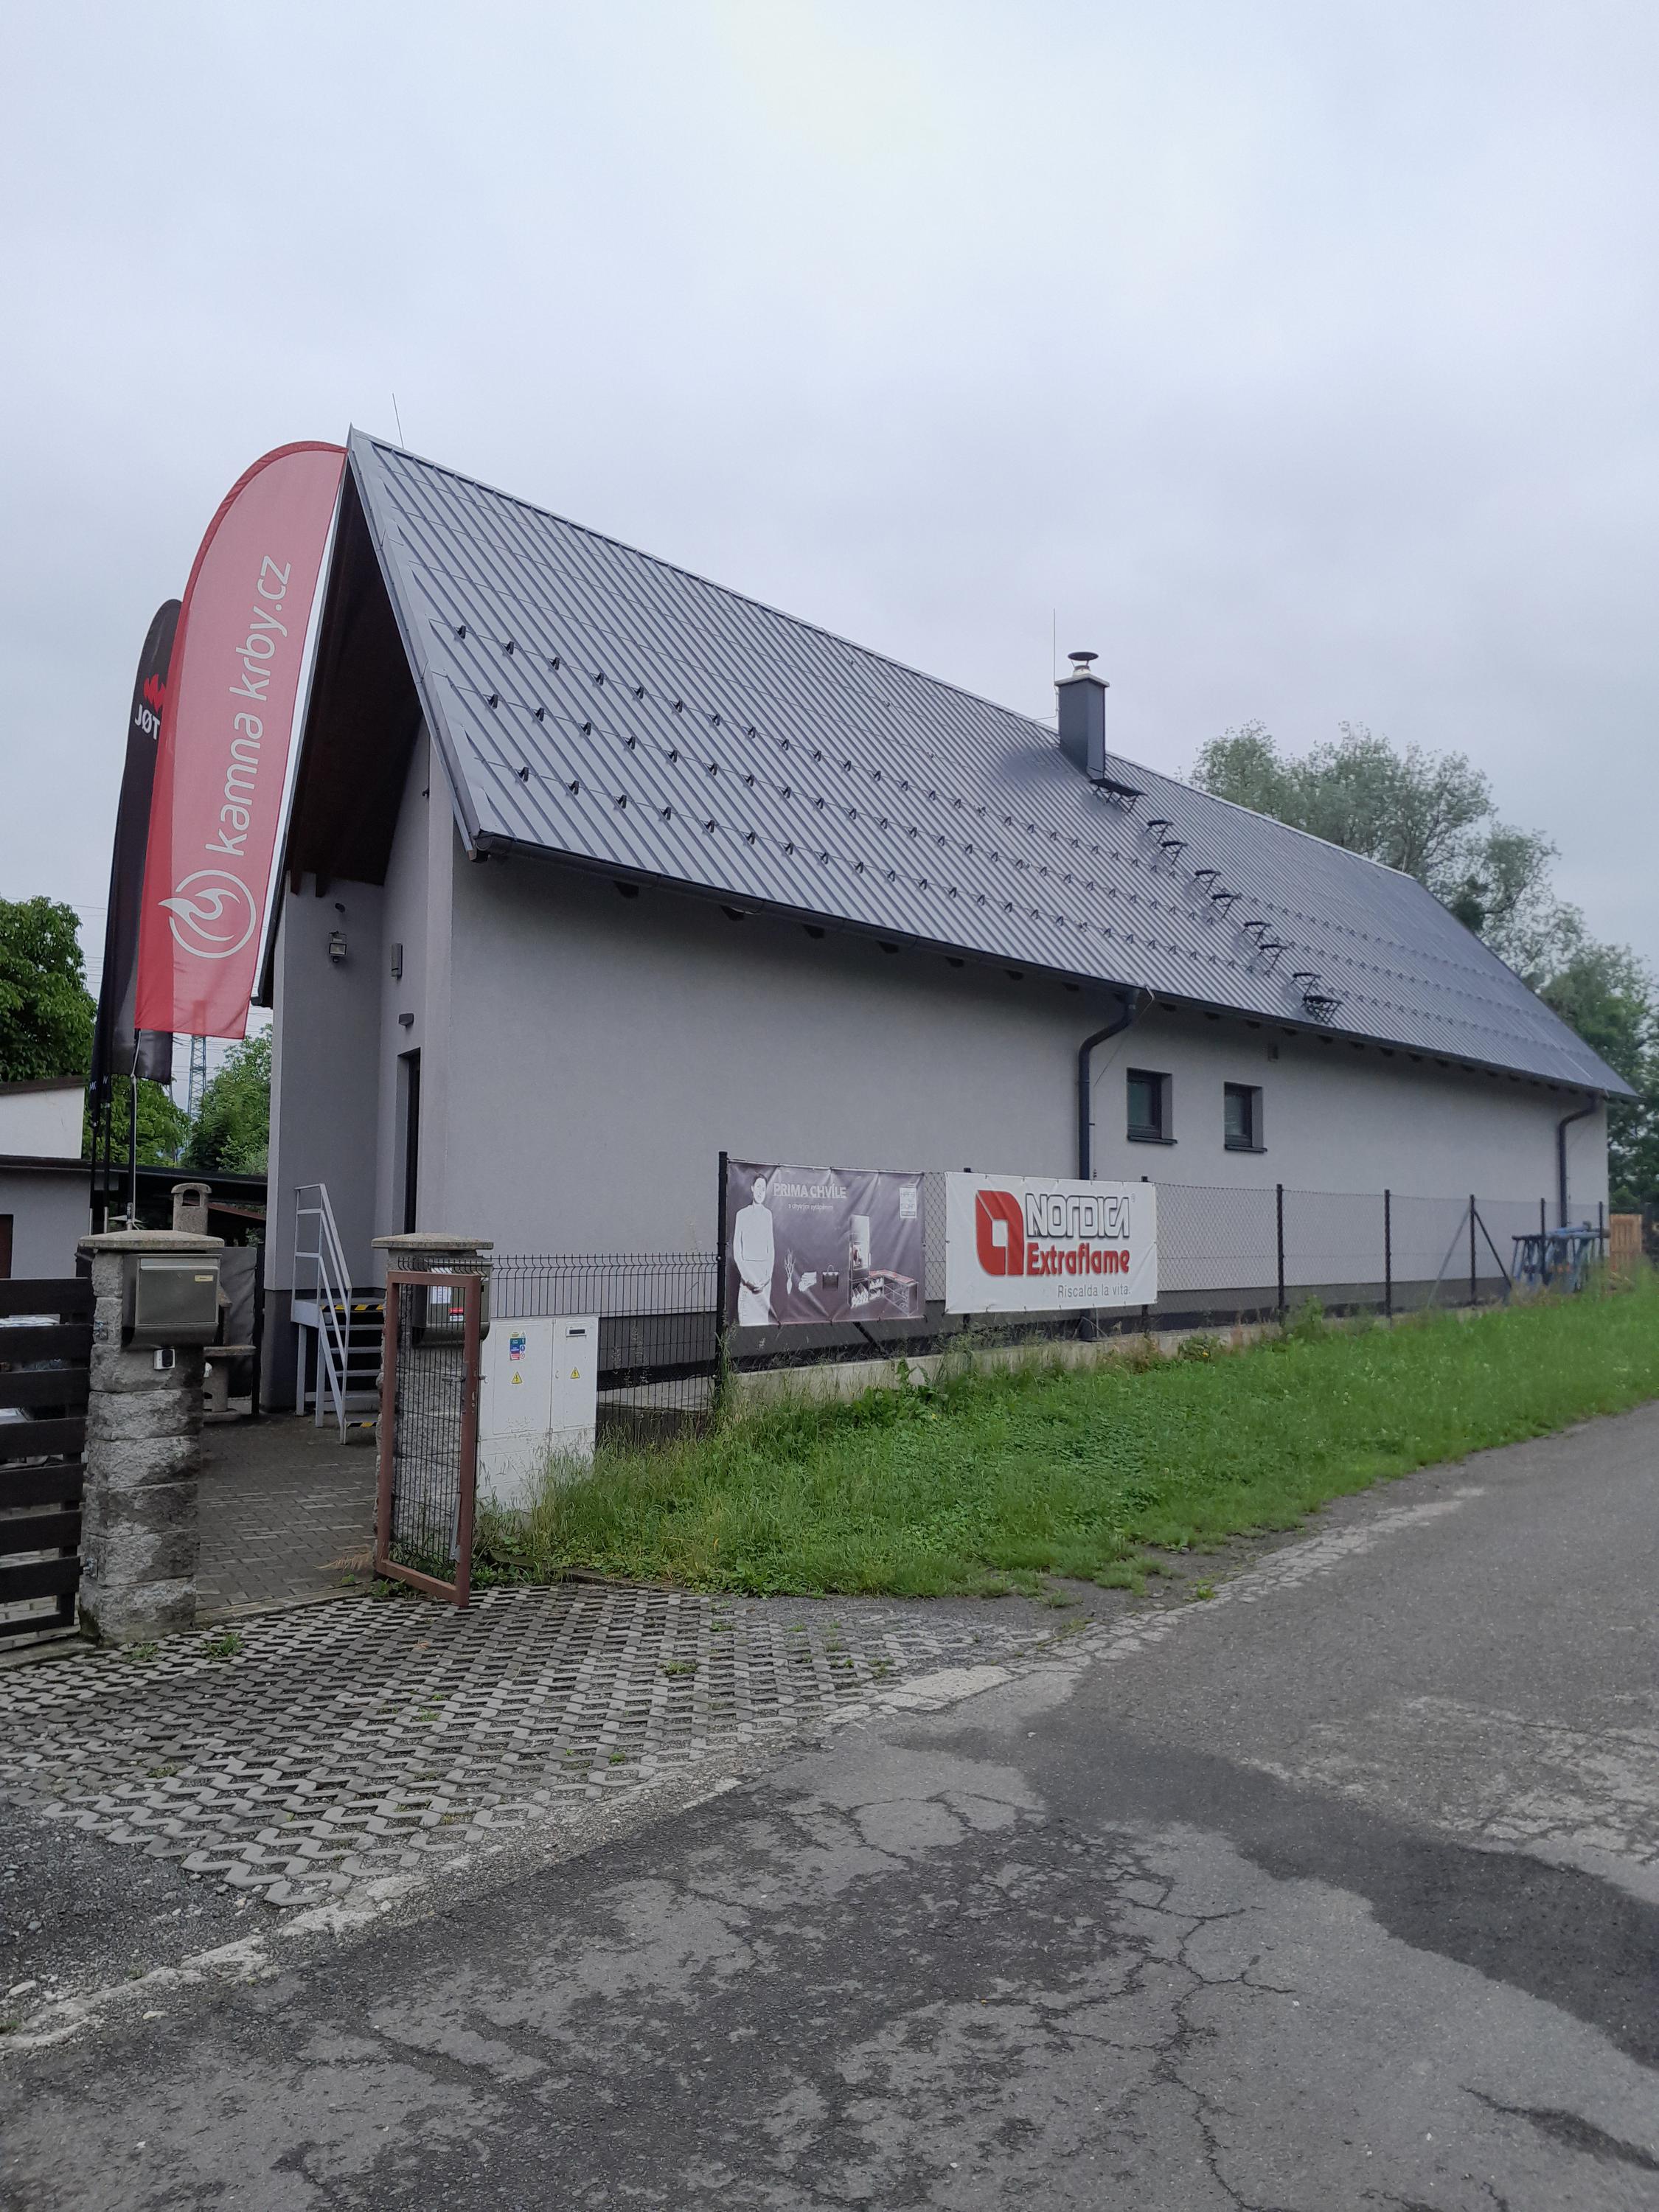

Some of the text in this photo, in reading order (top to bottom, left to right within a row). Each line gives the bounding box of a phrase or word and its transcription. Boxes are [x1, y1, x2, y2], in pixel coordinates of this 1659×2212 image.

[134, 703, 161, 740] JØT
[205, 554, 292, 856] kamna krby.cz
[773, 1183, 808, 1197] PRIMA
[1026, 1242, 1130, 1276] Extraflame
[1057, 1283, 1131, 1298] Riscalda la vita.
